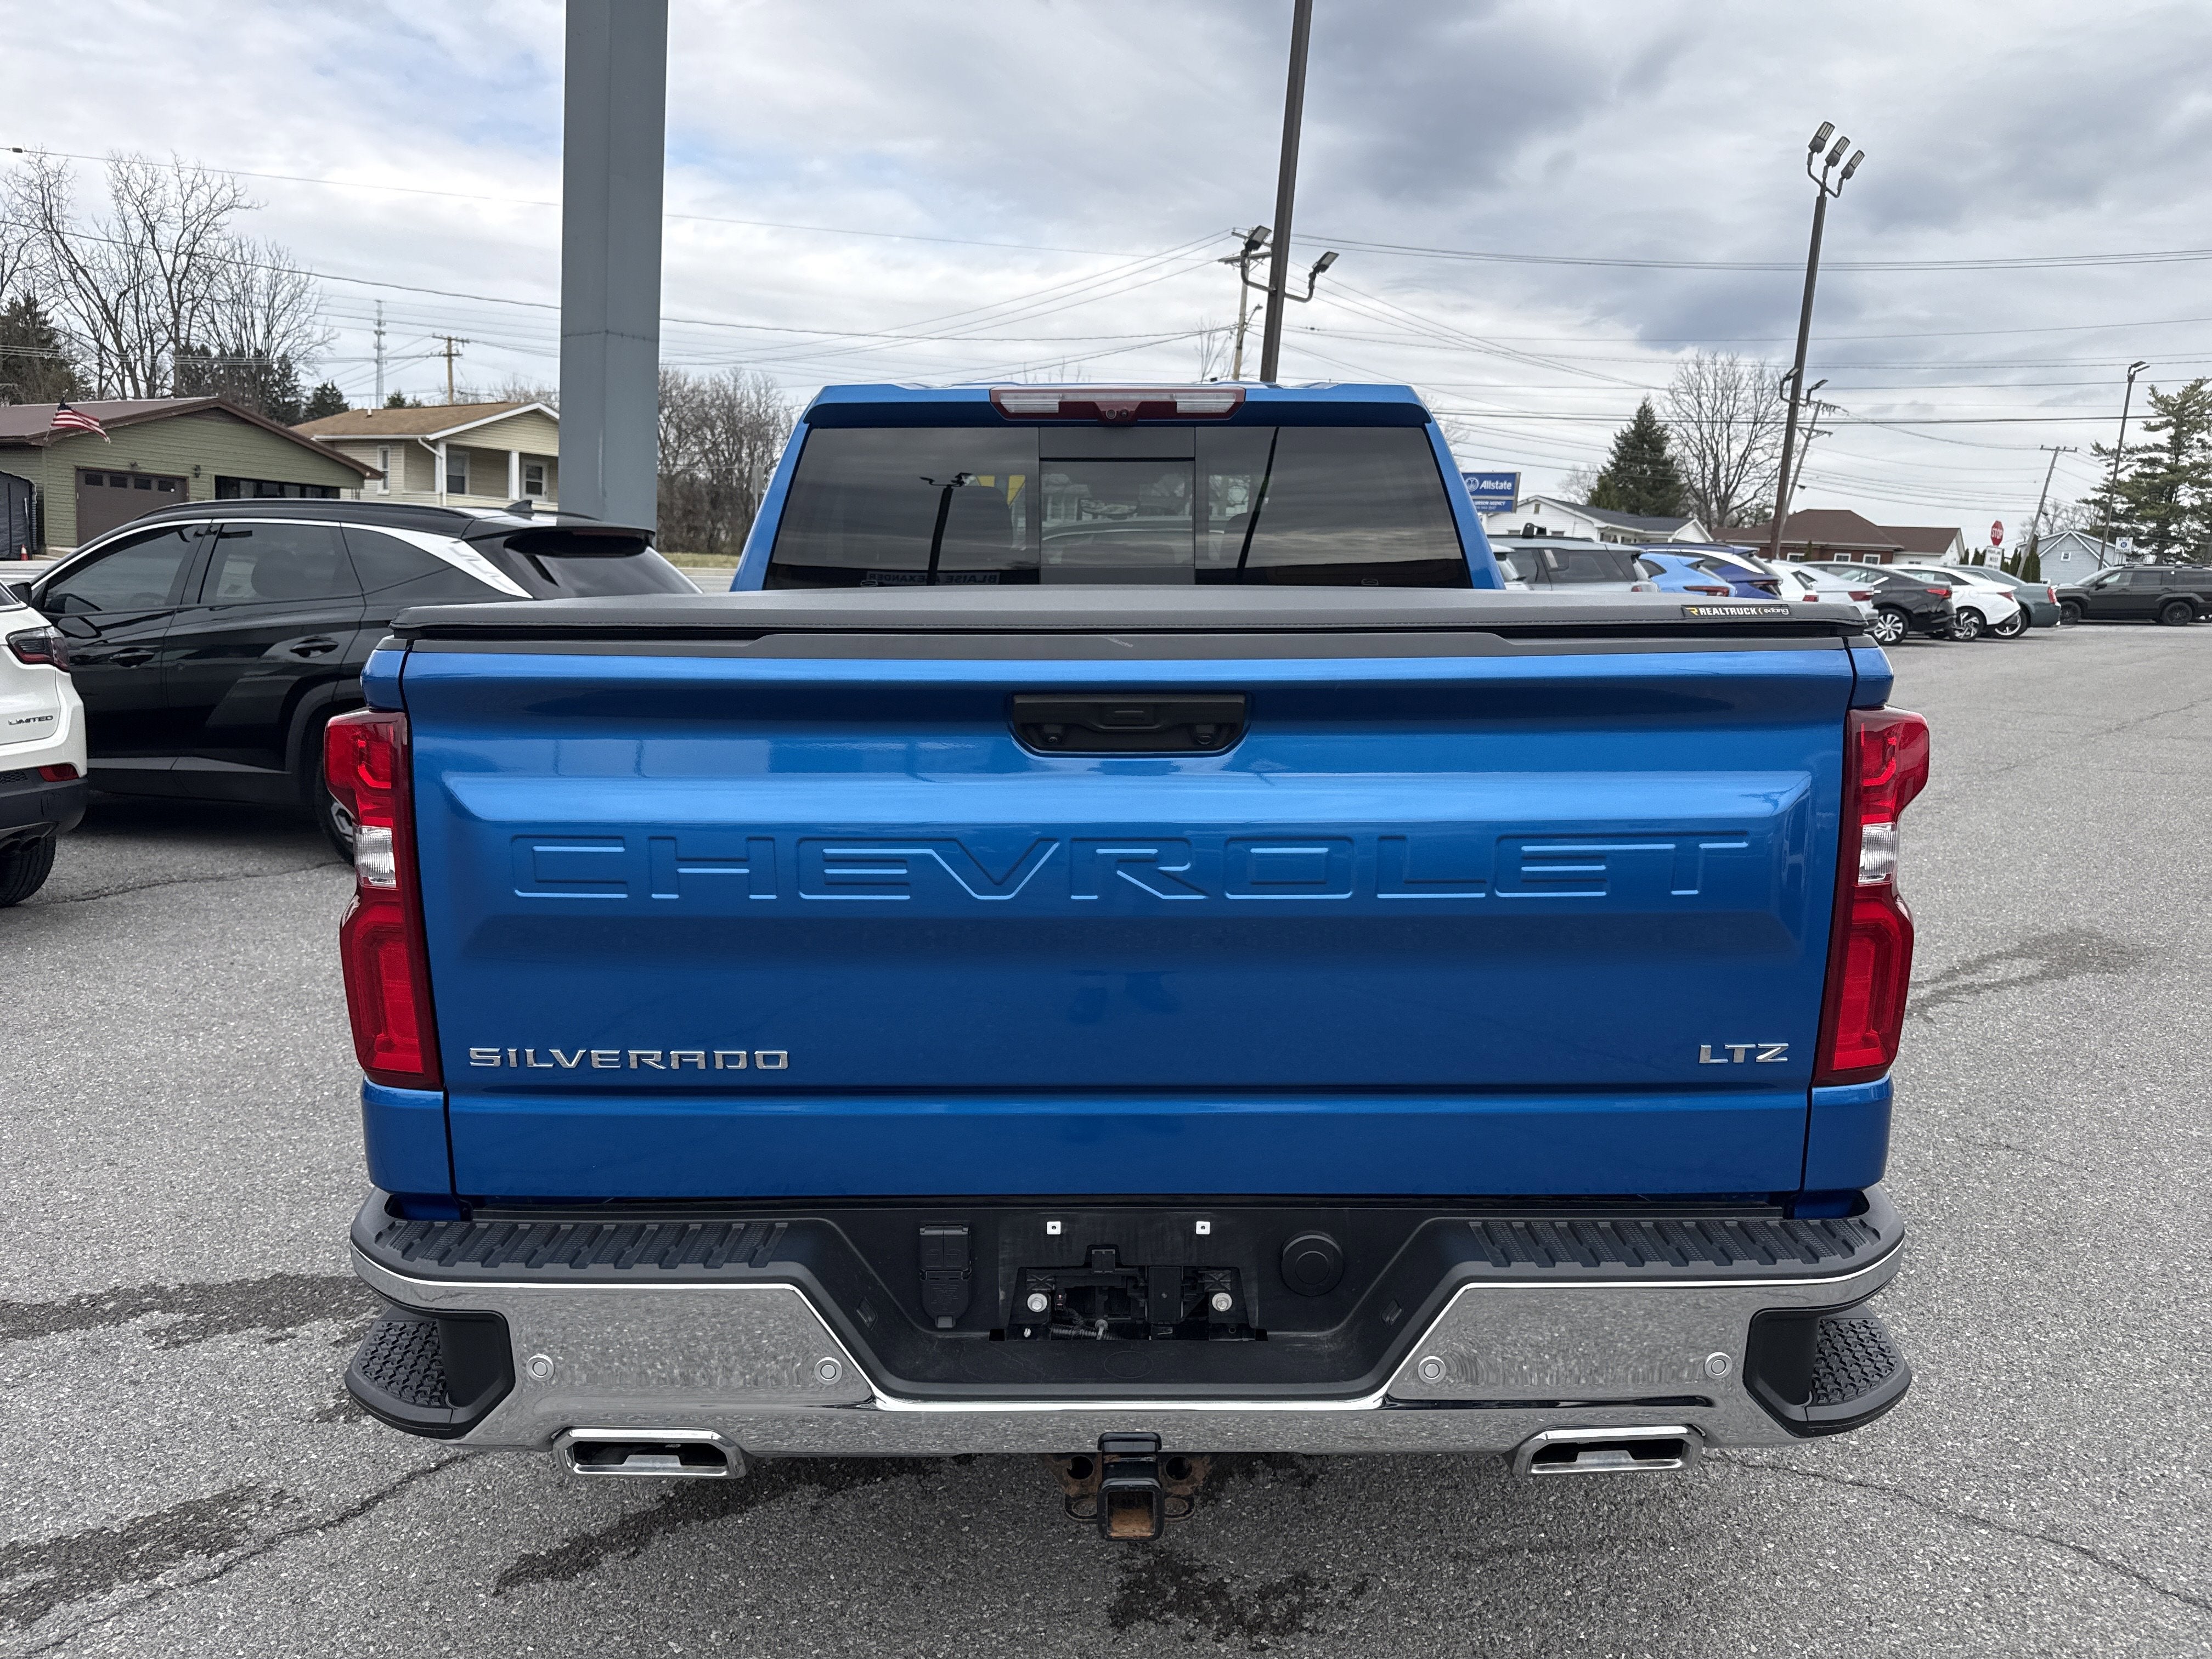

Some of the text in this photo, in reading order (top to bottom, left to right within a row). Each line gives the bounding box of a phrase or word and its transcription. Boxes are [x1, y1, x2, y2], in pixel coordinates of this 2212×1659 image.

[1479, 480, 1512, 490] Allstate
[1991, 527, 2003, 540] STOP
[1700, 607, 1789, 616] REALTRUCK extang
[8, 715, 53, 725] LIMITED
[510, 830, 1750, 899] CHEVROLET
[469, 1047, 789, 1069] SILVERADO
[1699, 1042, 1789, 1064] LTZ
